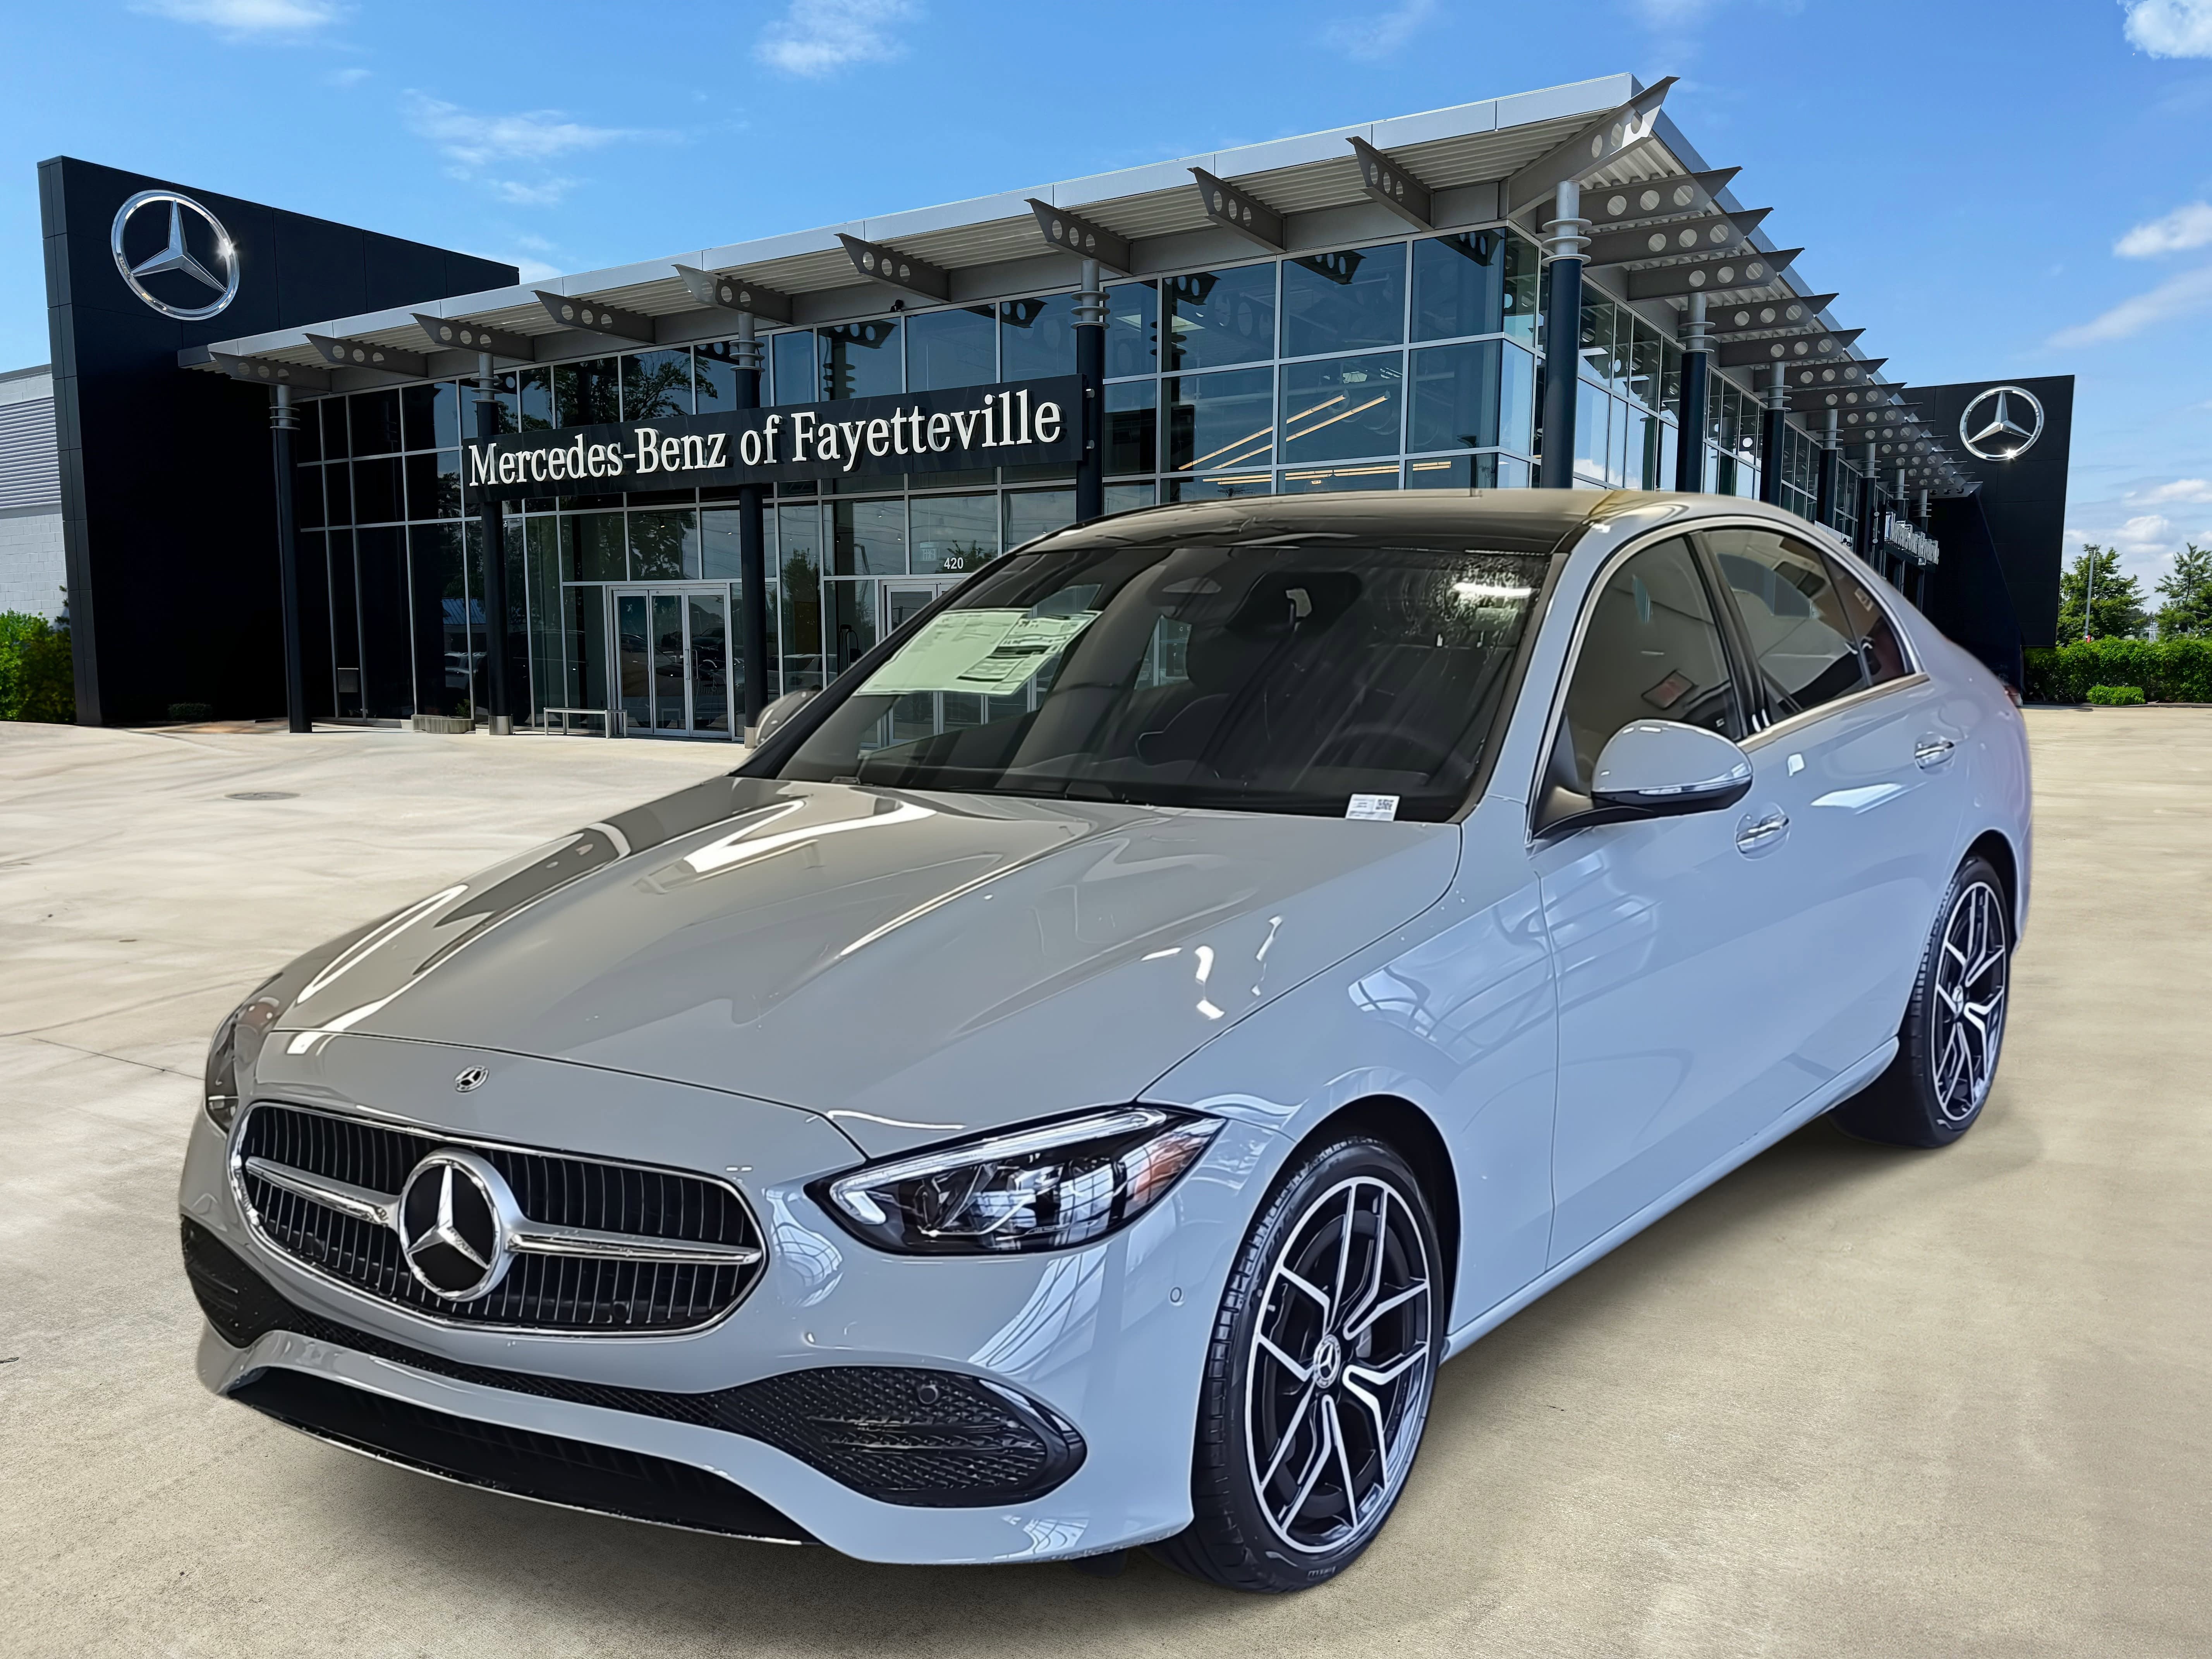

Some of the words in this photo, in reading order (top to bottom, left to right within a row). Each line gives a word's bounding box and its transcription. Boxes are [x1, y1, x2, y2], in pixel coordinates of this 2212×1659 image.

[468, 427, 726, 487] Mercedes-Benz
[740, 414, 783, 466] of
[790, 388, 1061, 472] Fayetteville
[944, 557, 963, 569] 420
